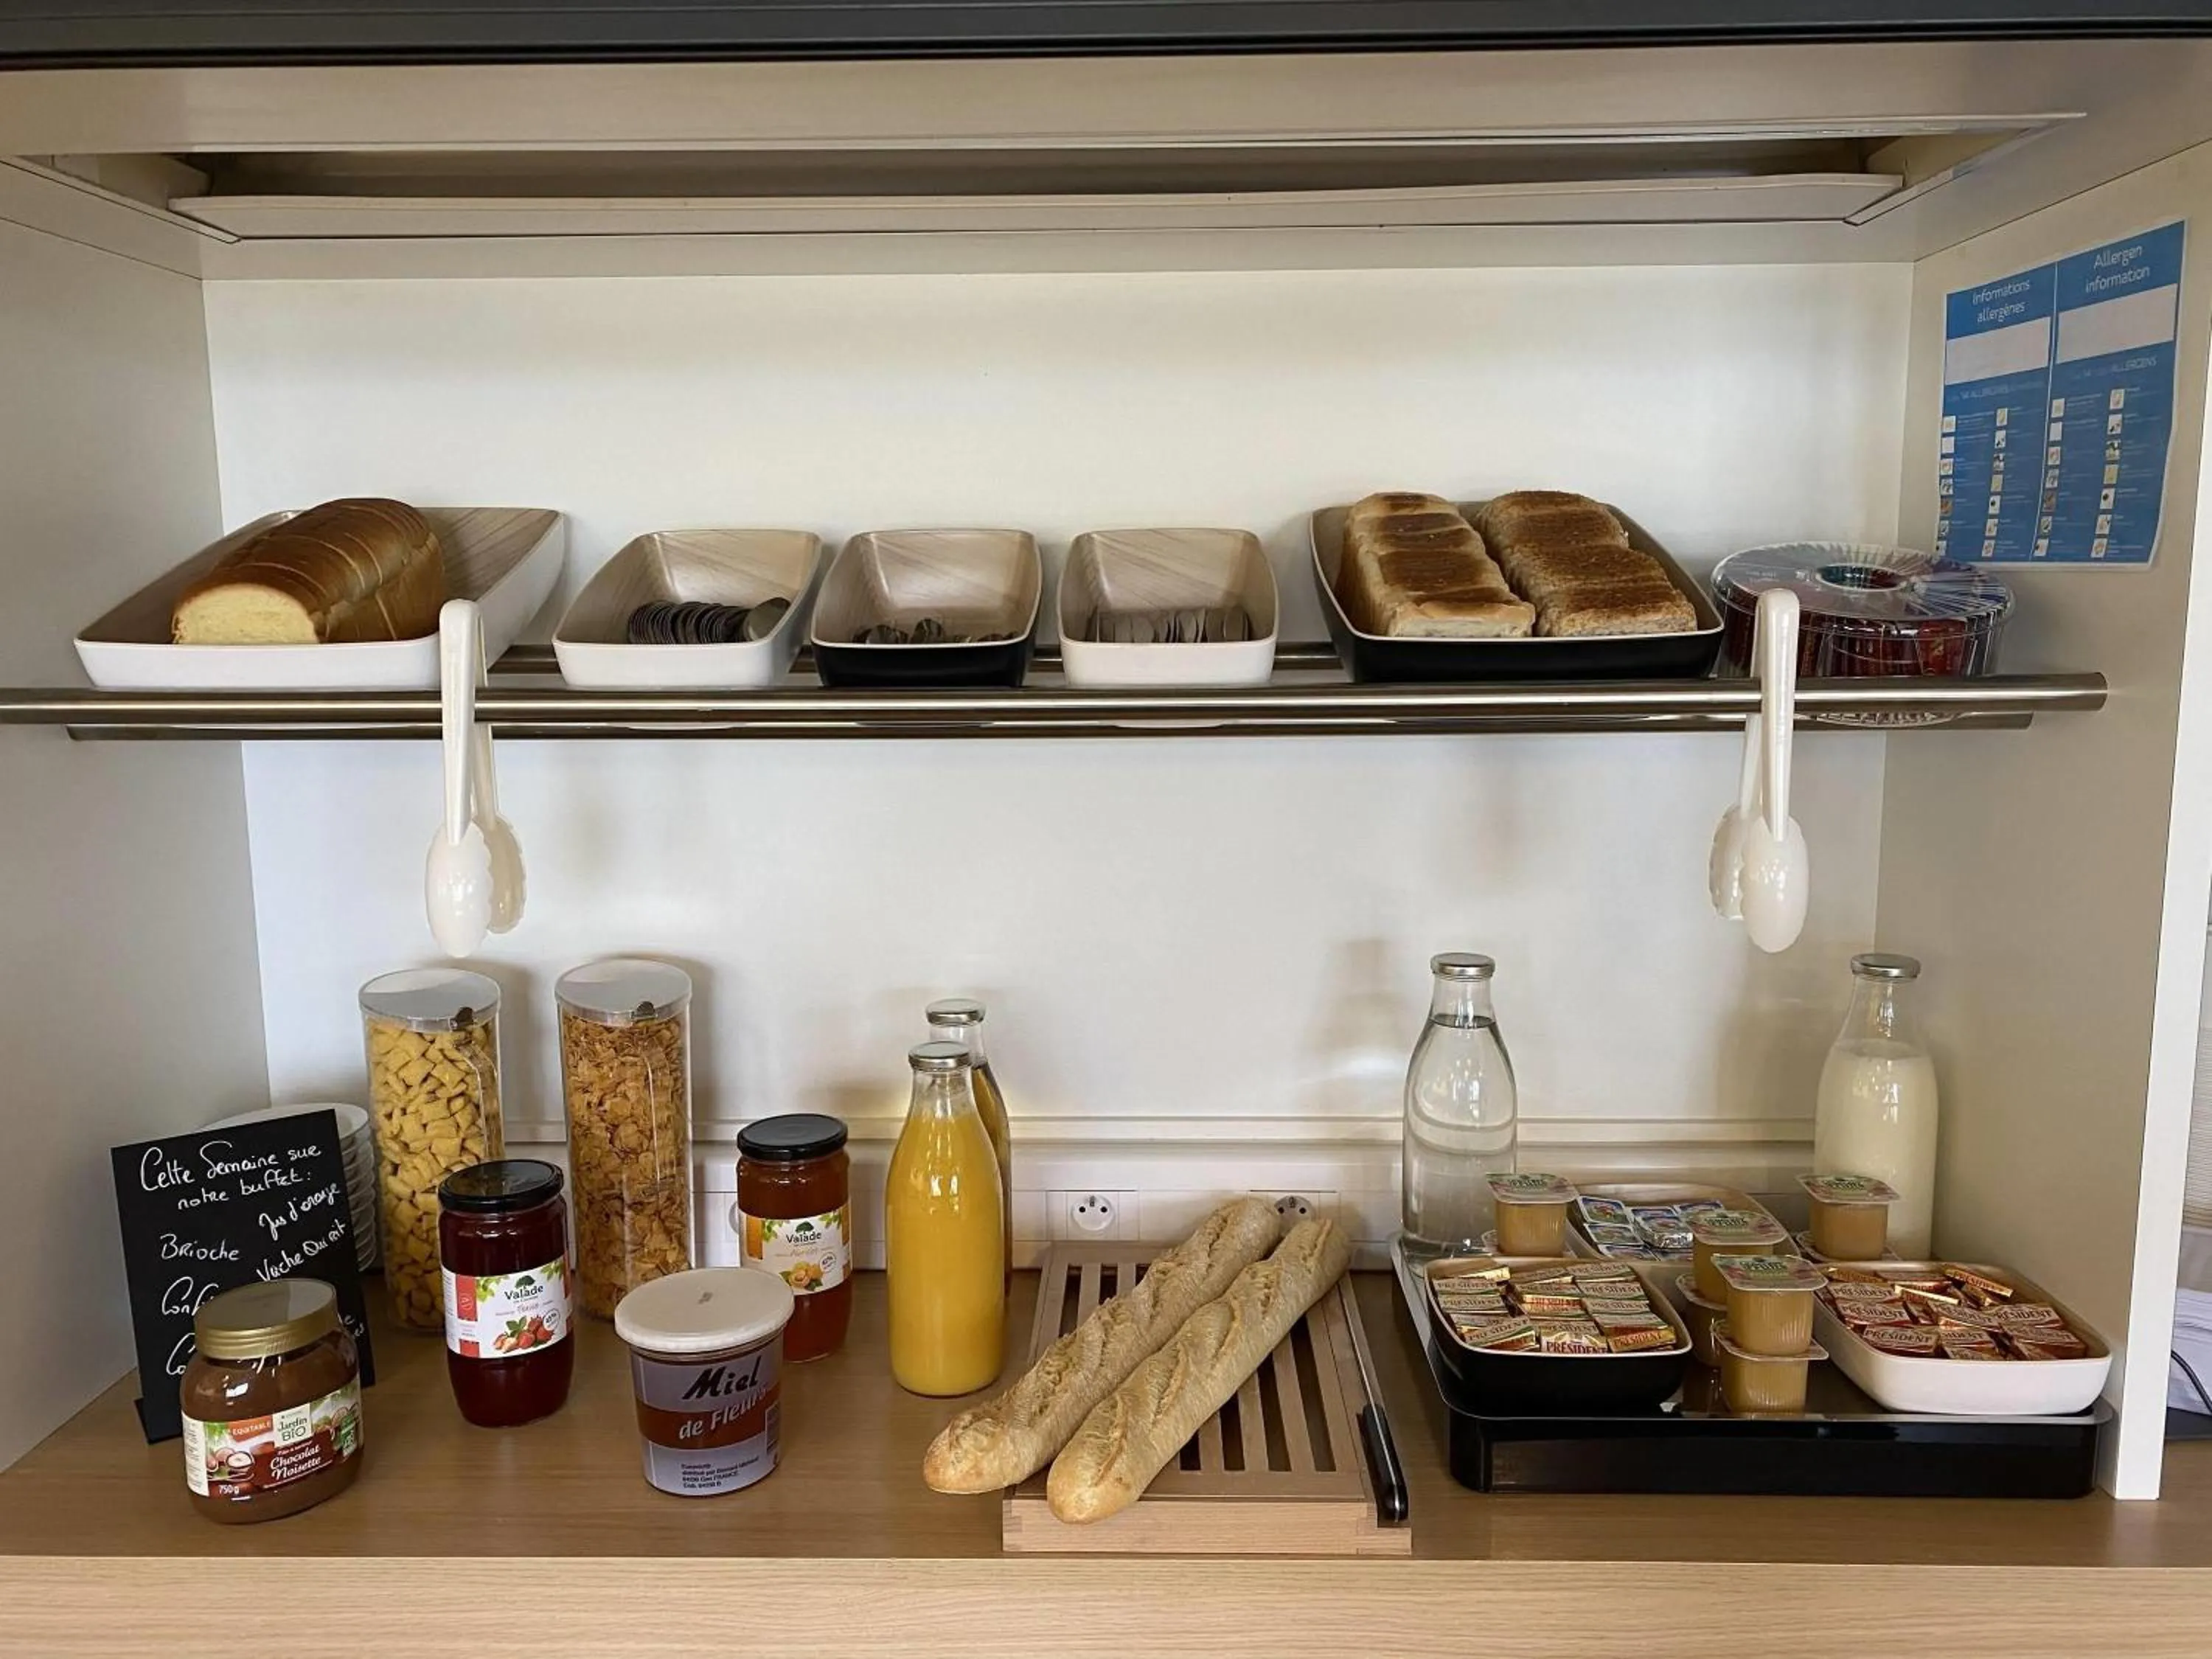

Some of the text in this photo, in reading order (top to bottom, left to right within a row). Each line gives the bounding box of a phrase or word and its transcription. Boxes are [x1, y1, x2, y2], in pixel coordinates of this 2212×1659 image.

[2094, 246, 2143, 269] Allergen
[2085, 266, 2150, 293] information
[1977, 301, 2026, 322] allergènes
[140, 1147, 195, 1192] Cette
[200, 1141, 279, 1179] Semaine
[177, 1187, 230, 1210] notre
[259, 1213, 288, 1242] Jus
[786, 1231, 822, 1244] Valade
[159, 1233, 241, 1261] Brioche
[257, 1250, 305, 1282] Vache
[504, 1284, 544, 1301] Valade
[681, 1355, 762, 1399] Miel
[277, 1416, 307, 1433] Jardin
[679, 1388, 768, 1439] de Fleurs
[270, 1444, 320, 1471] Chocolat
[271, 1456, 322, 1481] Noisette
